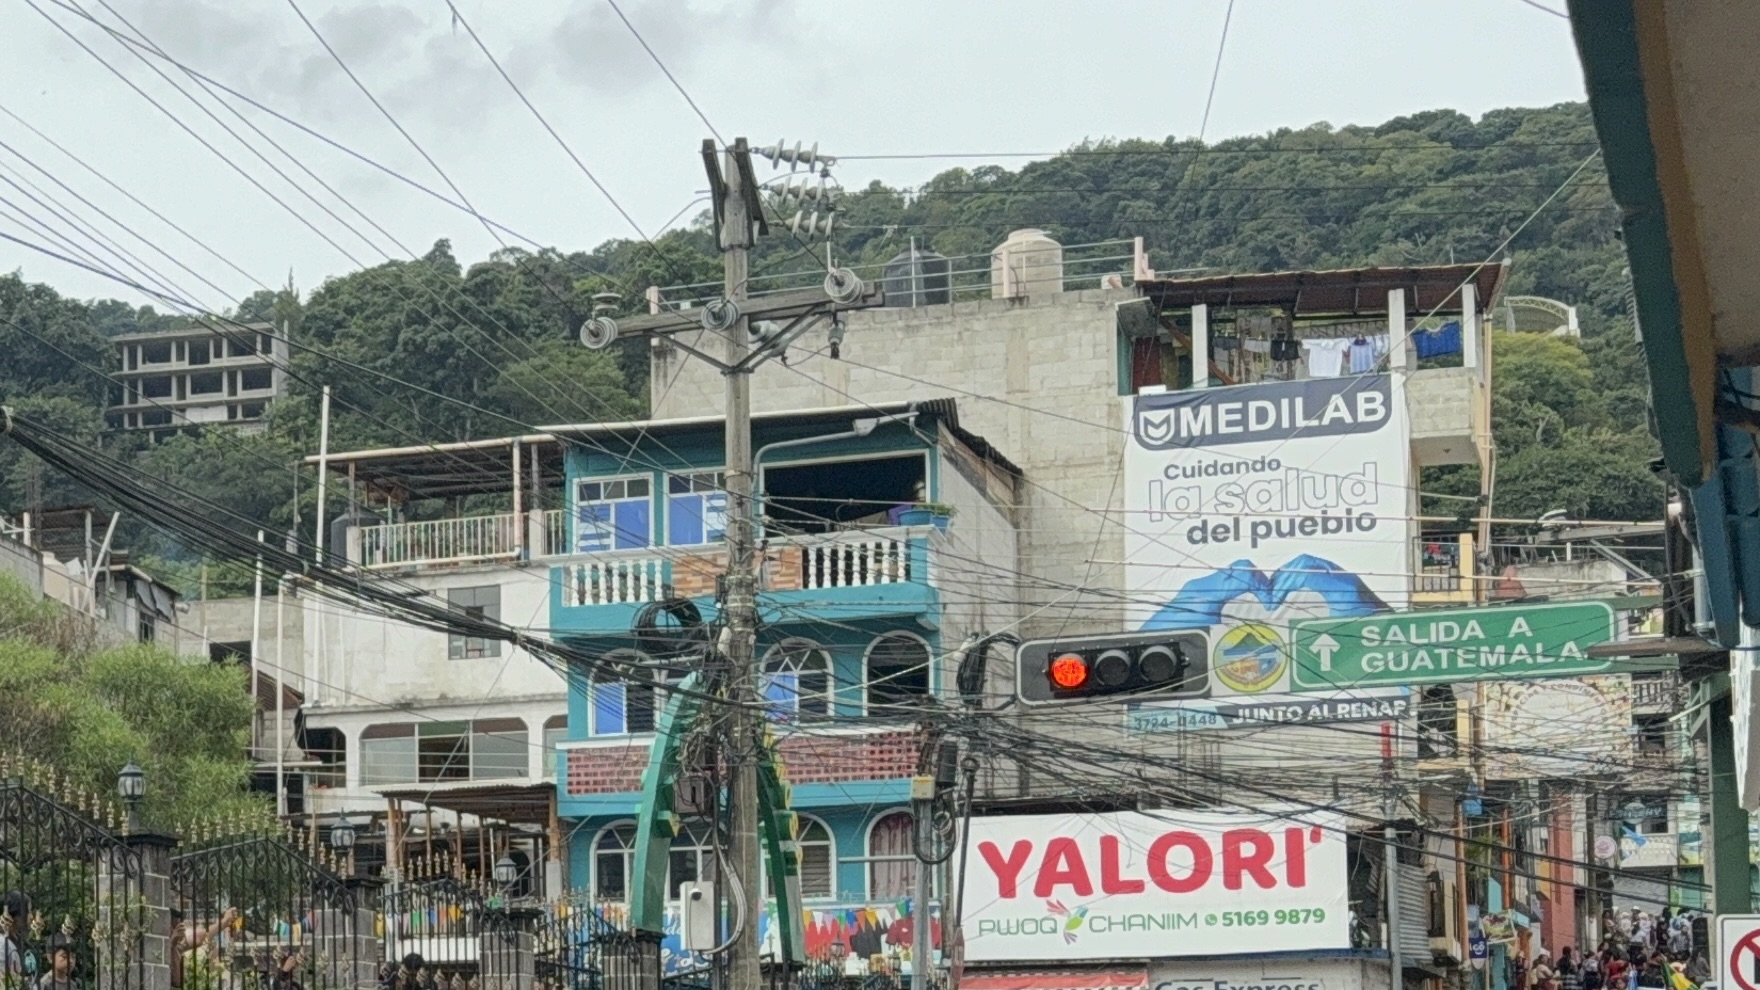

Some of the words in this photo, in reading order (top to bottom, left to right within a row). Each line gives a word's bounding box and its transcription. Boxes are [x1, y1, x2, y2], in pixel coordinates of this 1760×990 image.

[1179, 390, 1386, 438] MEDILAB
[1163, 455, 1282, 480] Cuidando
[1148, 479, 1202, 523] la
[1214, 461, 1379, 514] salud
[1186, 517, 1240, 545] del
[1250, 508, 1377, 549] pueblo
[1360, 619, 1486, 647] SALIDA
[1507, 616, 1535, 639] A
[1360, 641, 1582, 673] GUATEMALA
[1232, 705, 1302, 724] JUNTO
[1307, 703, 1333, 721] AL
[1337, 700, 1408, 719] RENAP
[1089, 912, 1198, 935] CHANIIM
[1221, 909, 1269, 928] 5169
[1274, 907, 1326, 926] 9879
